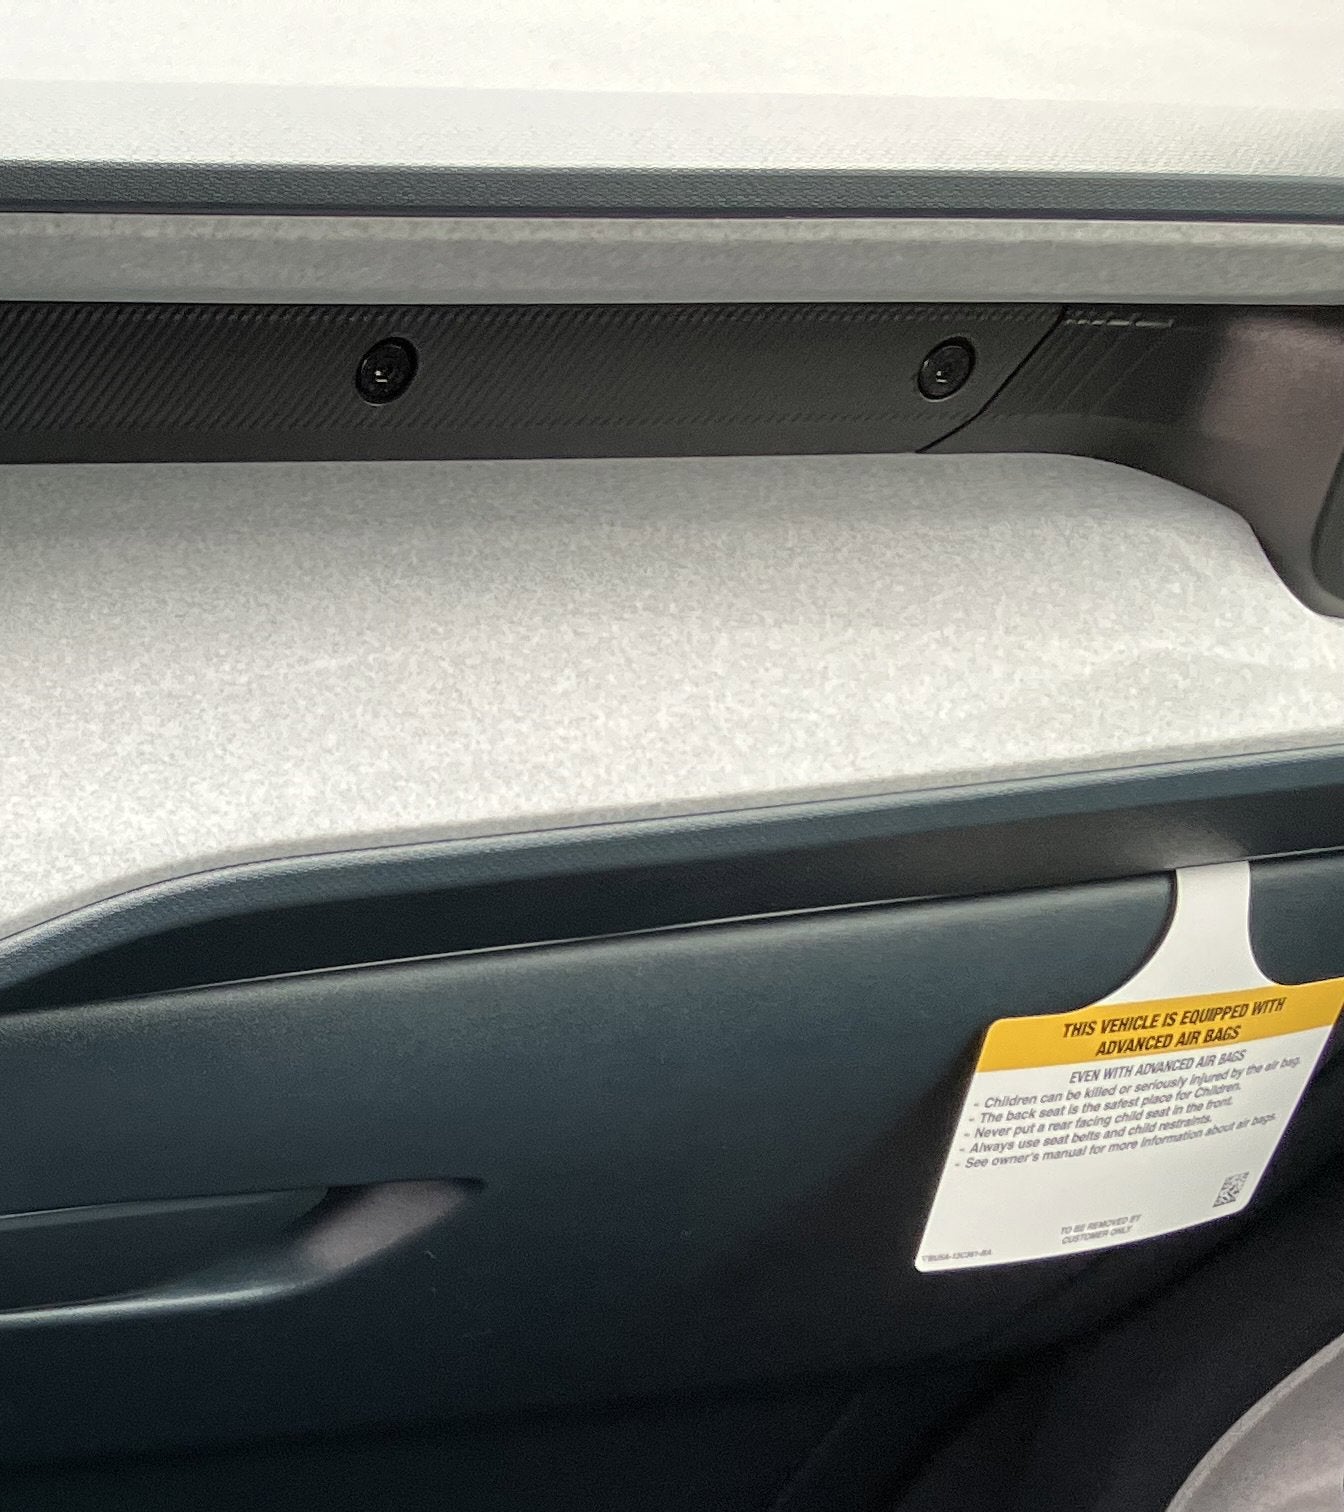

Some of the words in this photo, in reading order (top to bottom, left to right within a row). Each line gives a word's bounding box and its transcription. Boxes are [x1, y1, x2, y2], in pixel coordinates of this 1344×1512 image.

[1063, 1020, 1097, 1038] THIS
[1100, 1013, 1161, 1034] VEHICLE
[1161, 1011, 1179, 1028] IS
[1180, 1003, 1250, 1027] EQUIPPED
[1250, 997, 1288, 1017] WITH
[1095, 1032, 1174, 1057] ADVANCED
[1175, 1029, 1202, 1047] AIR
[1203, 1025, 1243, 1044] BAGS
[1069, 1069, 1101, 1084] EVEN
[1103, 1064, 1134, 1080] WITH
[1134, 1057, 1195, 1076] ADVANCED
[1195, 1054, 1217, 1069] AIR
[1217, 1049, 1248, 1066] BAGS
[984, 1095, 1037, 1109] Children
[1040, 1093, 1064, 1104] can
[1066, 1089, 1082, 1100] be
[1083, 1084, 1117, 1099] killed
[1119, 1085, 1132, 1094] or
[1134, 1076, 1189, 1092] seriously
[1230, 1067, 1245, 1080] by
[1246, 1063, 1264, 1075] the
[1264, 1060, 1281, 1071] air
[974, 1126, 1011, 1138] Never
[1013, 1123, 1034, 1137] put
[1037, 1124, 1045, 1133] a
[1047, 1121, 1073, 1132] rear
[1075, 1115, 1112, 1130] facing
[1114, 1109, 1145, 1123] child
[1145, 1106, 1172, 1119] seat
[1172, 1104, 1185, 1115] in
[1185, 1103, 1204, 1114] the
[980, 1112, 1003, 1124] The
[1006, 1108, 1036, 1122] back
[1039, 1106, 1066, 1119] seat
[1081, 1101, 1100, 1113] the
[1103, 1096, 1140, 1112] safest
[1140, 1094, 1173, 1109] place
[1175, 1090, 1192, 1101] for
[964, 1157, 989, 1169] See
[991, 1151, 1040, 1166] owner's
[1042, 1145, 1086, 1161] manual
[1088, 1143, 1107, 1156] for
[1108, 1140, 1138, 1153] more
[1204, 1121, 1235, 1137] about
[1235, 1117, 1252, 1130] air
[969, 1140, 1014, 1155] Always
[1017, 1139, 1040, 1150] use
[1042, 1134, 1069, 1147] seat
[1071, 1130, 1100, 1144] belts
[1102, 1126, 1127, 1139] and
[1127, 1122, 1158, 1136] child
